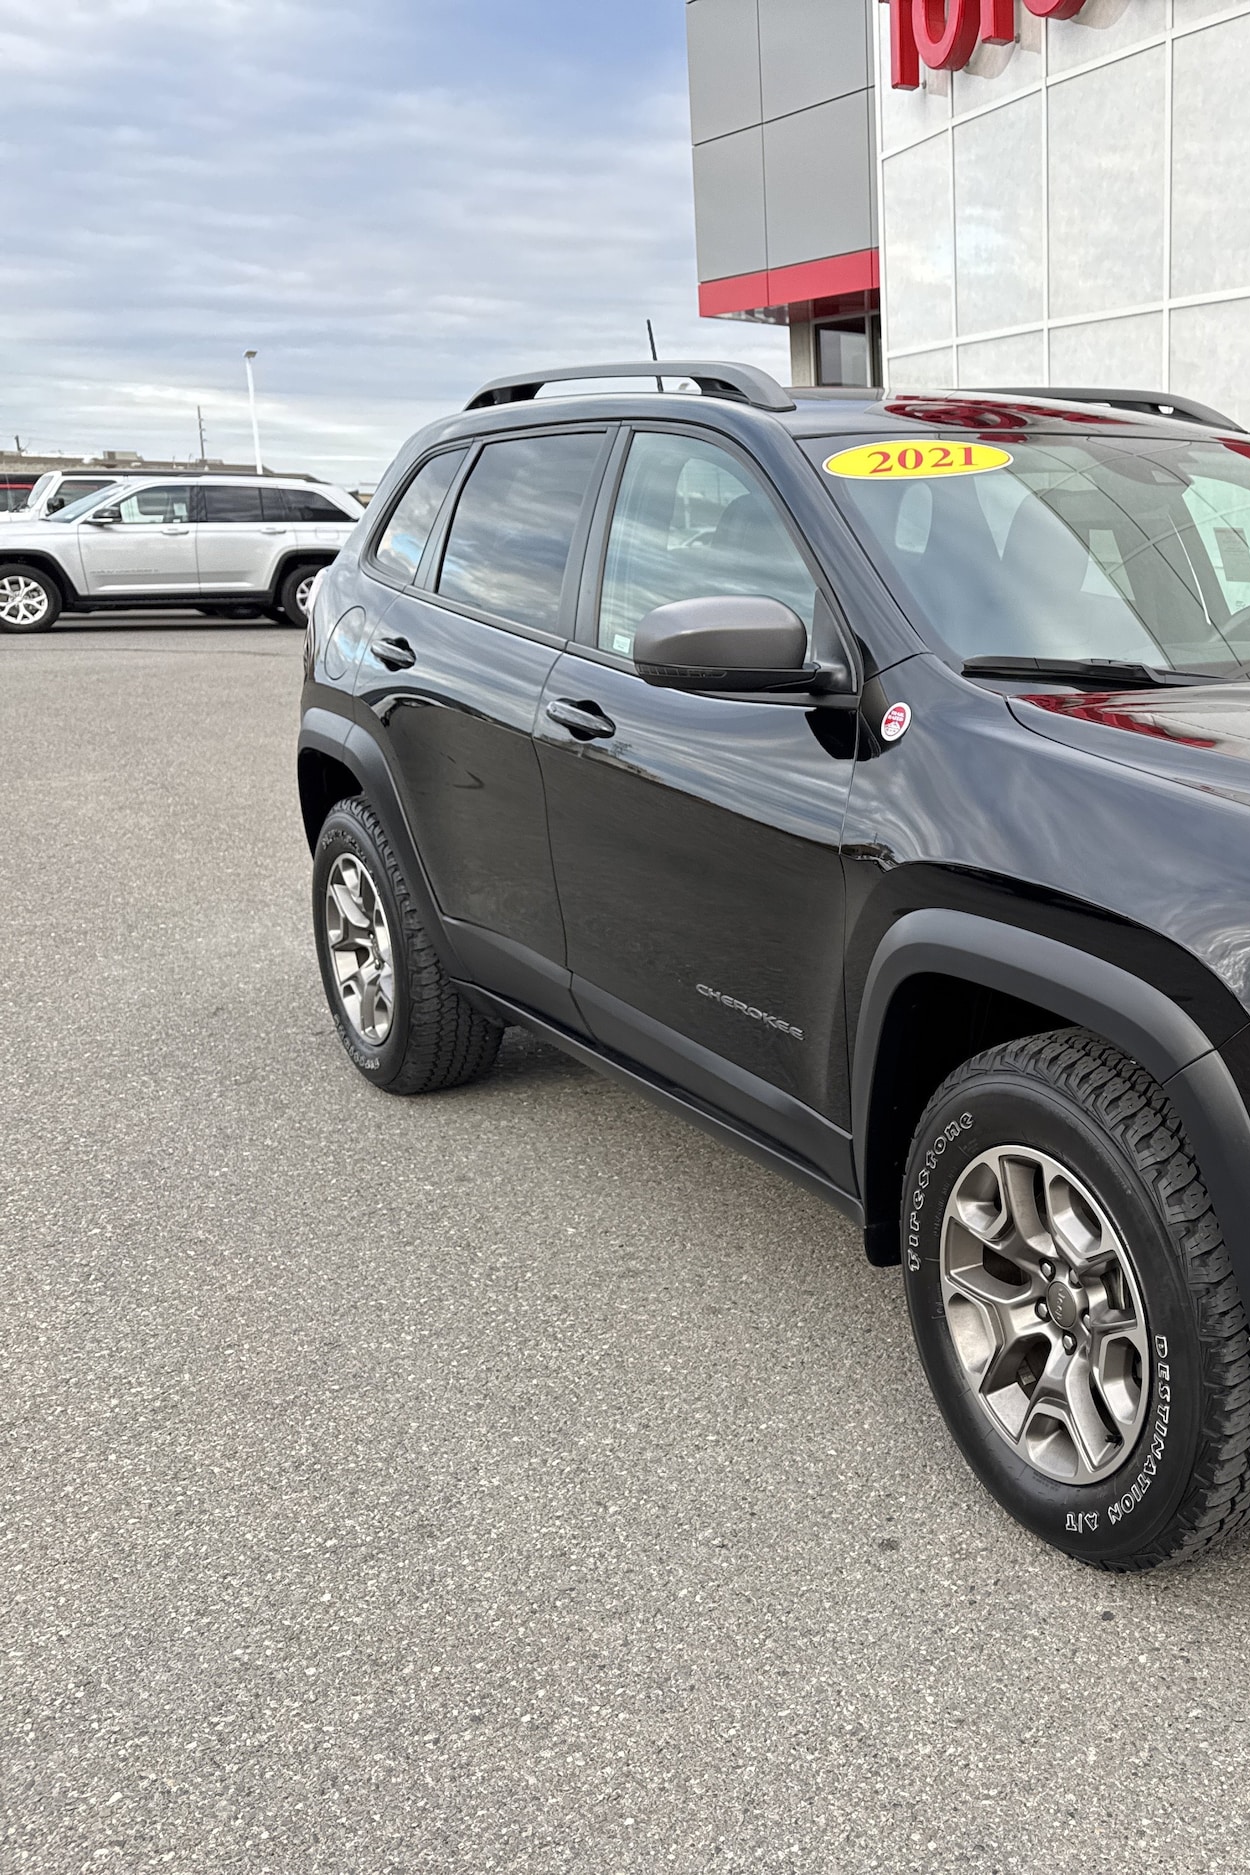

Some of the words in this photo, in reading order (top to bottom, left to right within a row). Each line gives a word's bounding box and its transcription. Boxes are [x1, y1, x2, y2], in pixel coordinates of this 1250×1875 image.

[867, 446, 978, 475] 2021
[696, 983, 805, 1041] CHEROKEE
[1108, 1335, 1171, 1525] DESTINATION
[1065, 1511, 1099, 1533] A/T
